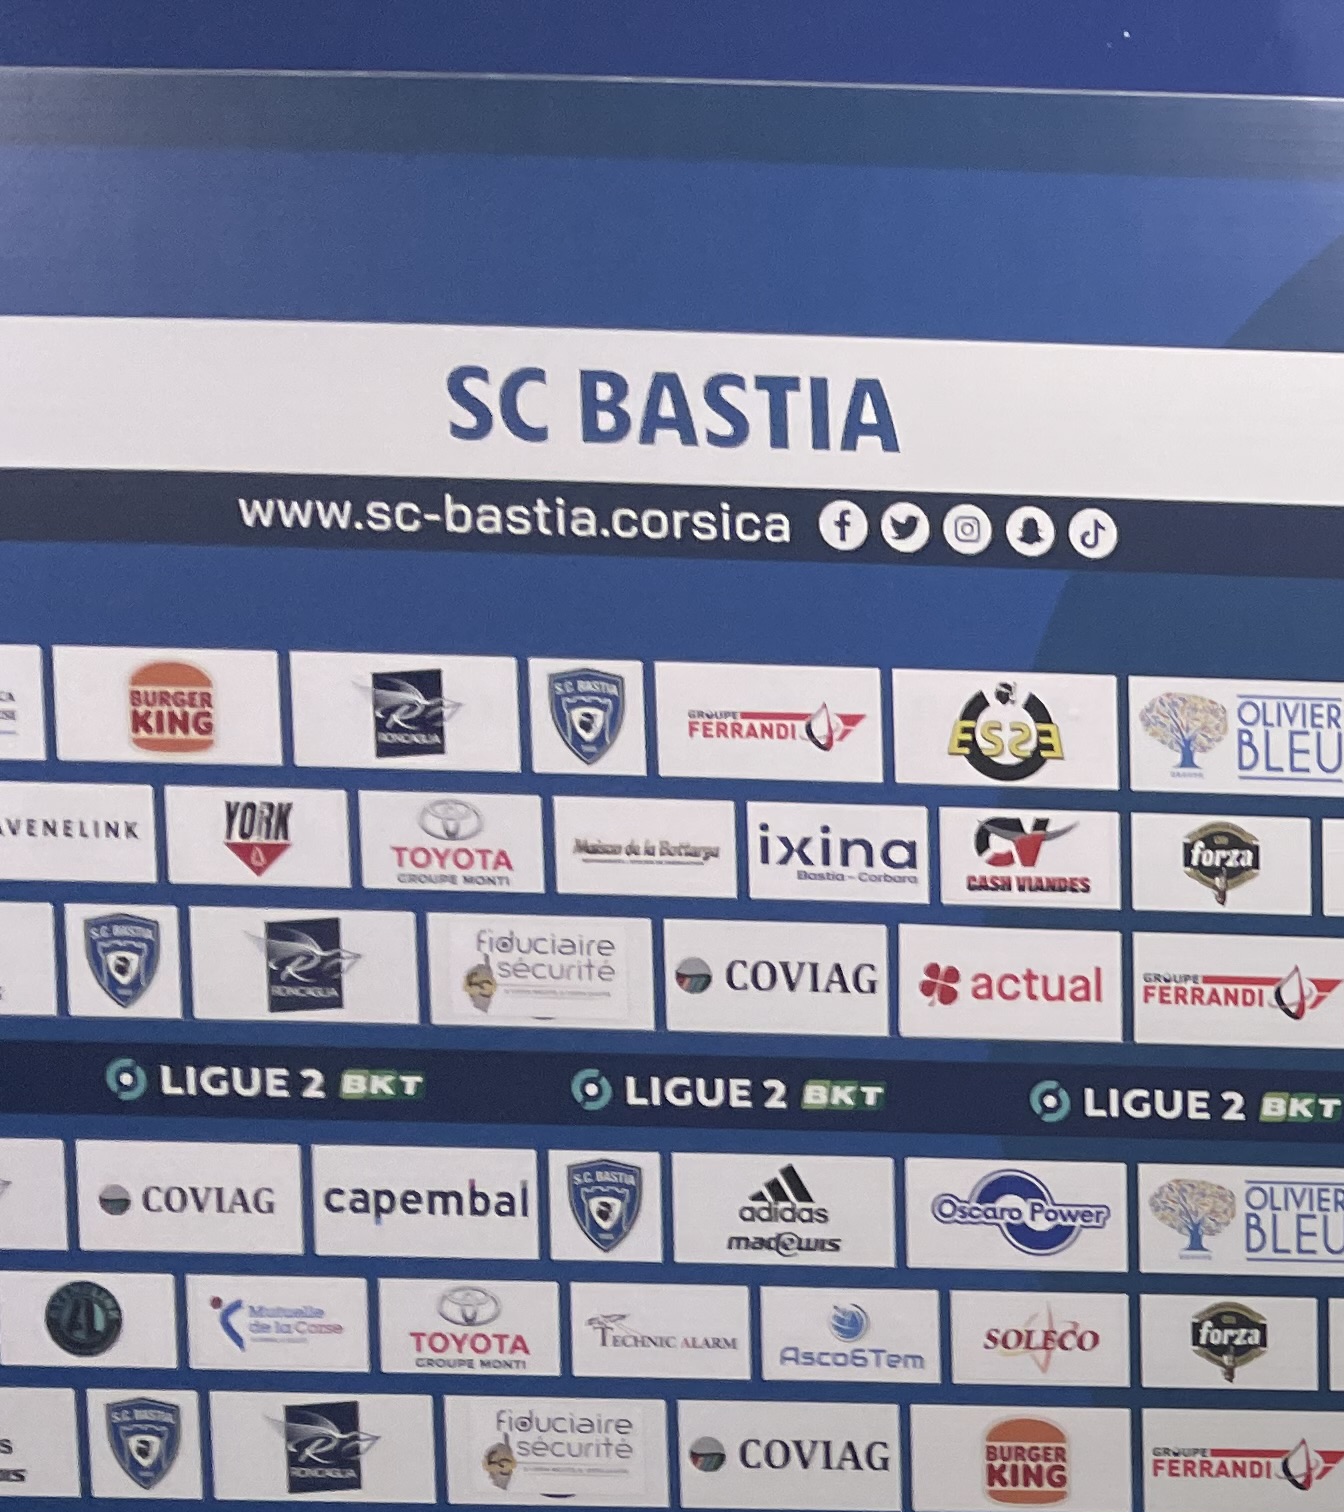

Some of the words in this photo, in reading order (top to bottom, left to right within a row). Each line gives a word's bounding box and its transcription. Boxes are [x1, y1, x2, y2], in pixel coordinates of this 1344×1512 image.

[447, 364, 548, 442] SC
[580, 369, 900, 453] BASTIA
[238, 492, 792, 544] www.sc-bastia.corsica
[129, 690, 213, 708] BURGER
[131, 711, 214, 736] KING
[1238, 700, 1342, 729] OLIVIER
[688, 722, 797, 740] FERRANDI
[1238, 730, 1343, 774] BLEU
[224, 801, 293, 841] YORK
[391, 846, 514, 871] TOYOTA
[758, 823, 918, 870] ixina
[1190, 843, 1255, 869] forza
[967, 876, 1012, 892] CASH
[1017, 876, 1090, 894] VIANDES
[725, 960, 877, 994] COVIAG
[971, 966, 1102, 1003] actual
[1143, 973, 1199, 984] GROUPE
[1143, 986, 1264, 1008] FERRANDI
[160, 1065, 290, 1098] LIGUE
[301, 1068, 325, 1099] 2
[343, 1074, 423, 1095] BKT
[1083, 1087, 1210, 1120] LIGUE
[1221, 1090, 1246, 1121] 2
[1262, 1096, 1342, 1118] BKT
[142, 1186, 275, 1214] COVIAG
[323, 1179, 529, 1225] capembal
[738, 1203, 829, 1223] adidas
[410, 1331, 530, 1356] TOYOTA
[598, 1326, 677, 1349] TECHNIC
[681, 1335, 738, 1350] ALARM
[983, 1328, 1099, 1351] SOLECO
[738, 1439, 890, 1472] COVIAG
[986, 1446, 1067, 1463] BURGER
[1153, 1447, 1208, 1458] GROUPE
[987, 1464, 1067, 1489] KING
[1153, 1460, 1272, 1479] FERRANDI
